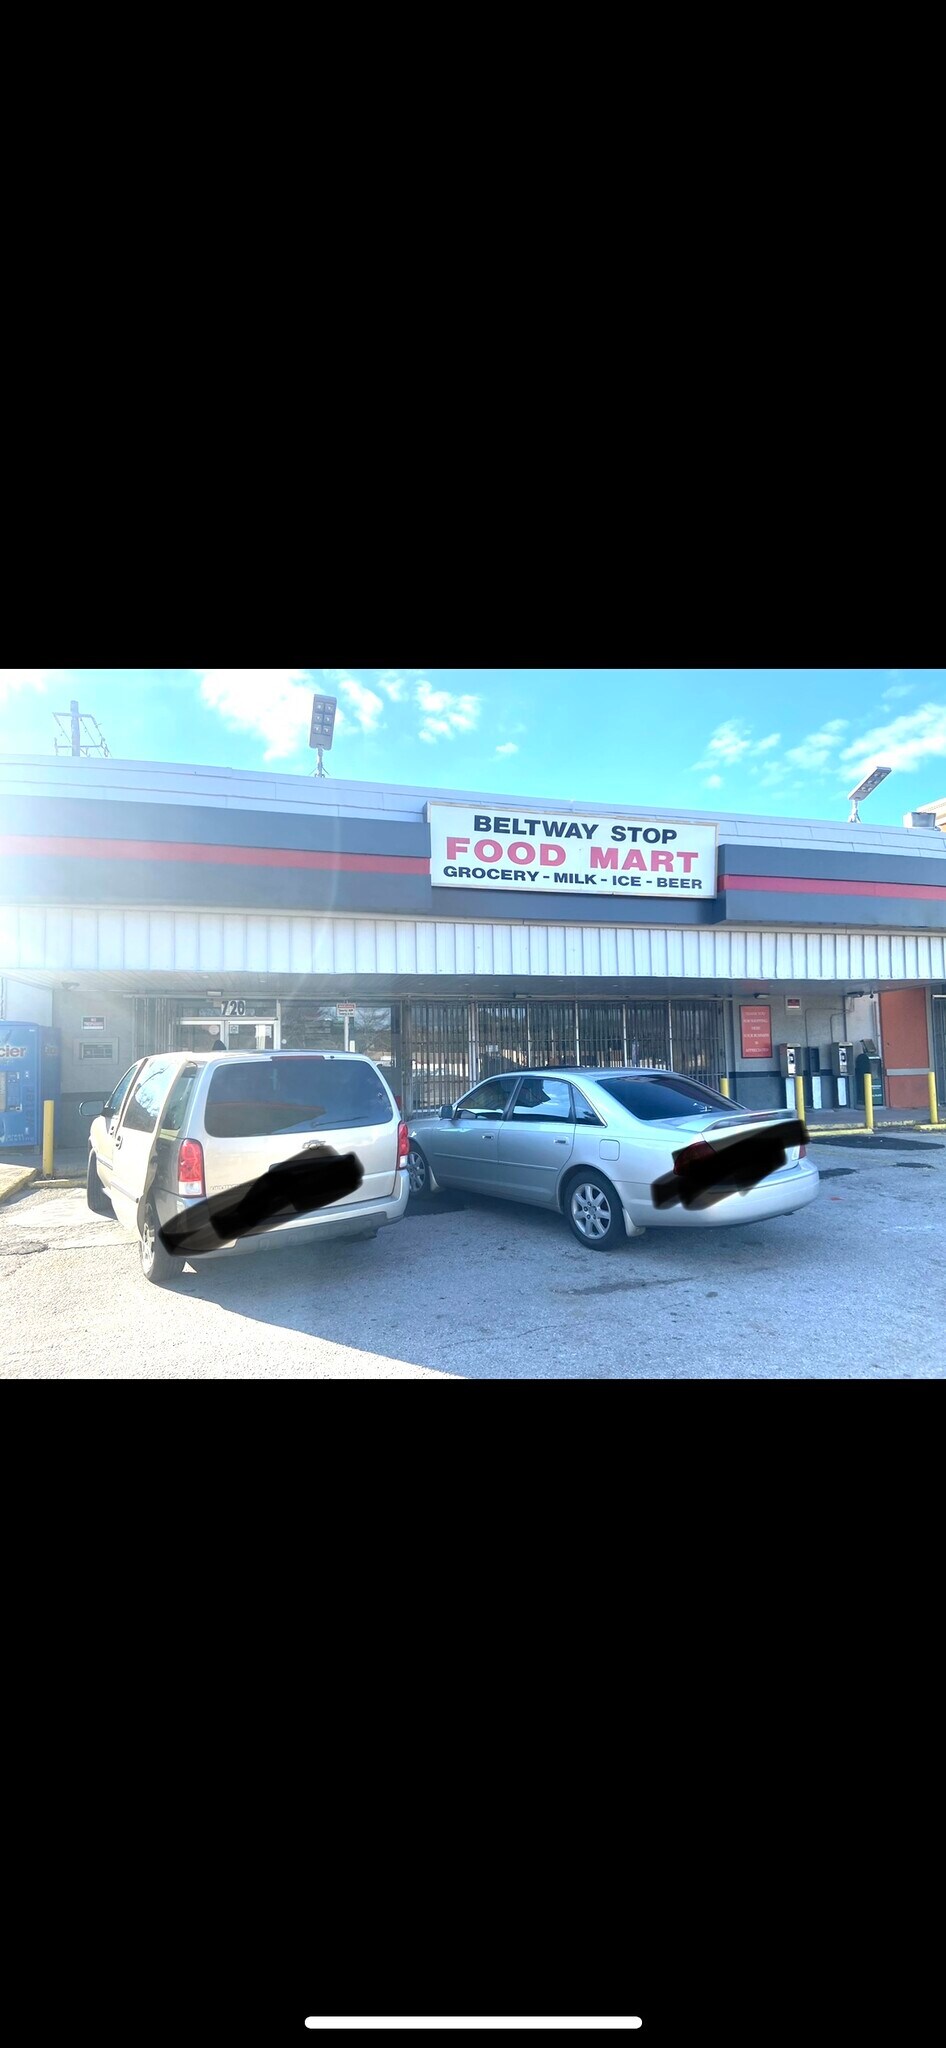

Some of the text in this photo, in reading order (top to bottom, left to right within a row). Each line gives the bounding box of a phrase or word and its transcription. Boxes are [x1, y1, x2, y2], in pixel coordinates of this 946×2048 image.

[473, 814, 678, 844] BELTWAY STOP
[446, 836, 699, 874] FOOD MART
[442, 865, 540, 883] GROCERY
[553, 872, 598, 885] MILK
[612, 875, 642, 887] ICE
[656, 877, 703, 890] BEER
[221, 1000, 246, 1016] 720
